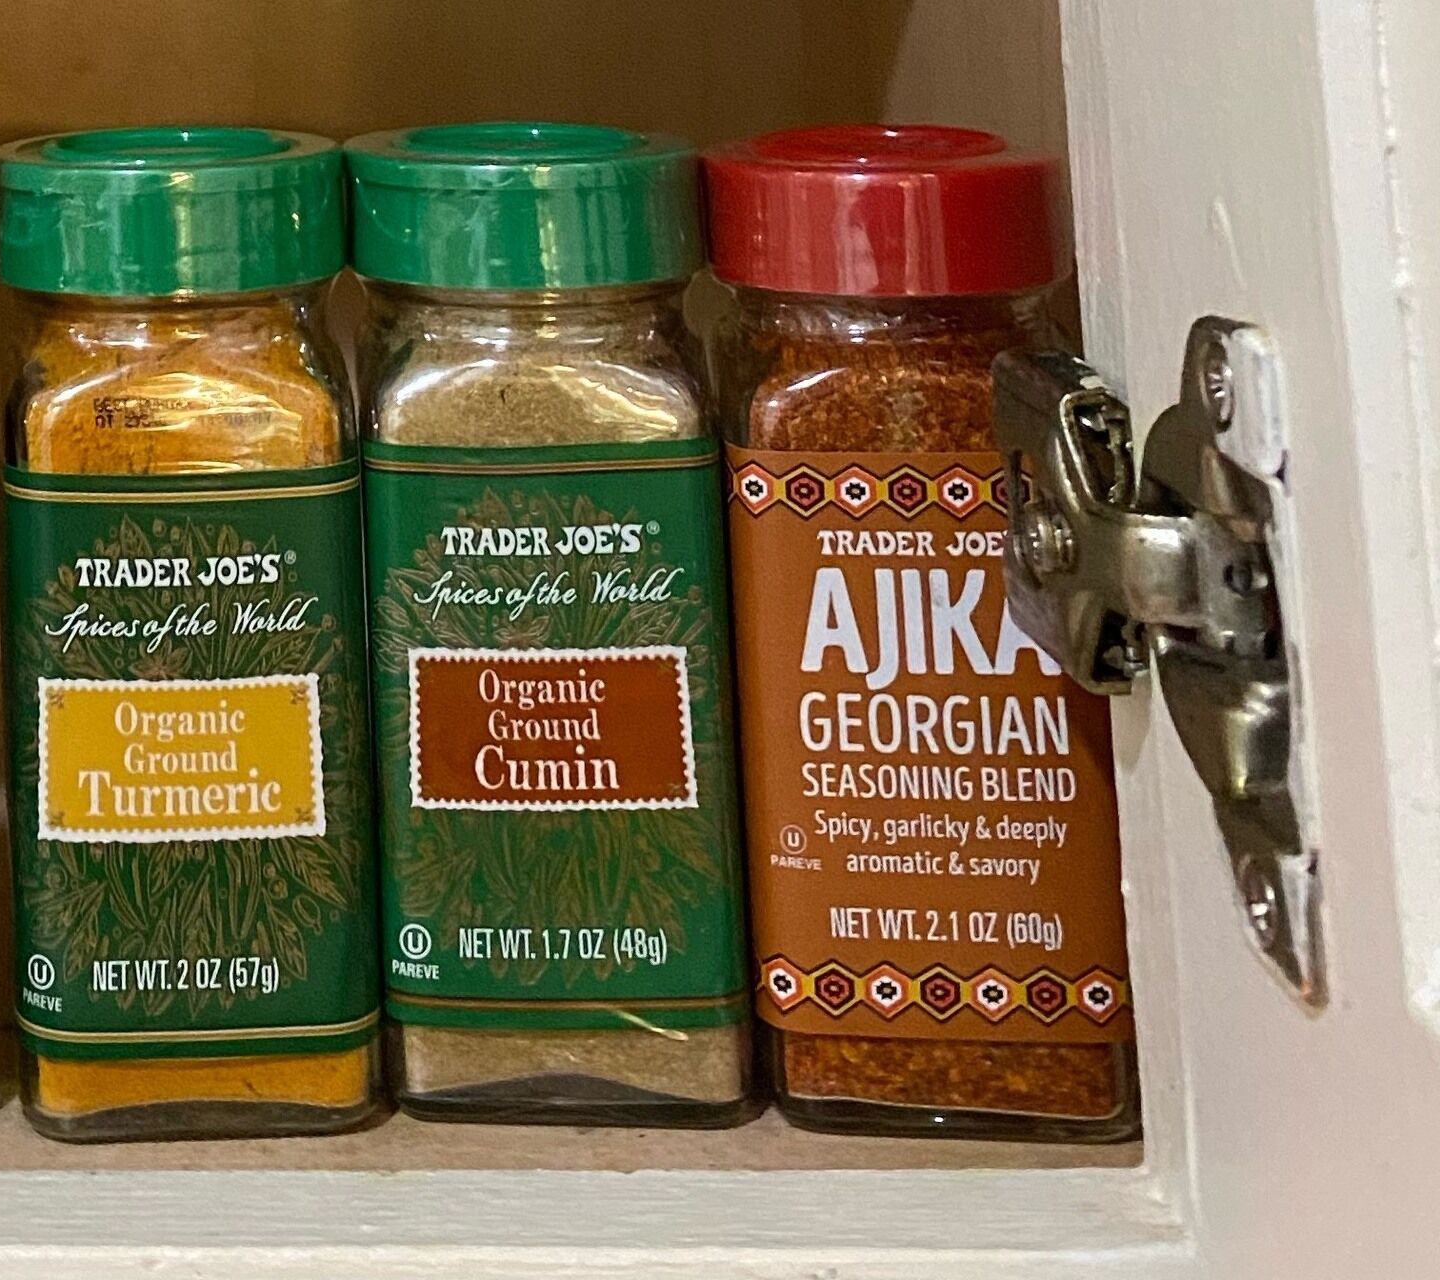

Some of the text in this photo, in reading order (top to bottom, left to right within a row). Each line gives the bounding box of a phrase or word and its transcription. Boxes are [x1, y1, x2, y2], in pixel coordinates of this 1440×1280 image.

[440, 527, 550, 557] TRADER
[817, 530, 935, 556] TRADER
[75, 558, 191, 587] TRADER
[413, 571, 503, 621] Spices
[591, 568, 686, 603] World
[45, 604, 142, 653] Spices
[232, 596, 318, 634] World
[479, 669, 606, 708] Organic
[114, 701, 246, 738] Organic
[488, 708, 601, 741] Ground
[800, 692, 1069, 754] GEORGIAN
[124, 740, 238, 775] Ground
[474, 746, 620, 791] Cumin
[78, 770, 282, 817] Turmeric
[802, 763, 1076, 802] SEASONING BLEND
[815, 811, 1067, 848] Spicy, garlicky & deeply
[770, 854, 821, 871] PAREVE
[846, 852, 1040, 885] aromatic & savory
[458, 928, 668, 963] NET WT. 1.7 OZ (48g)
[830, 907, 1063, 950] NET WT. 2.1 OZ (60g)
[92, 957, 279, 992] NET WT. 2 OZ (57g)
[391, 960, 439, 979] PAREVE
[23, 988, 63, 1012] PAREVE
